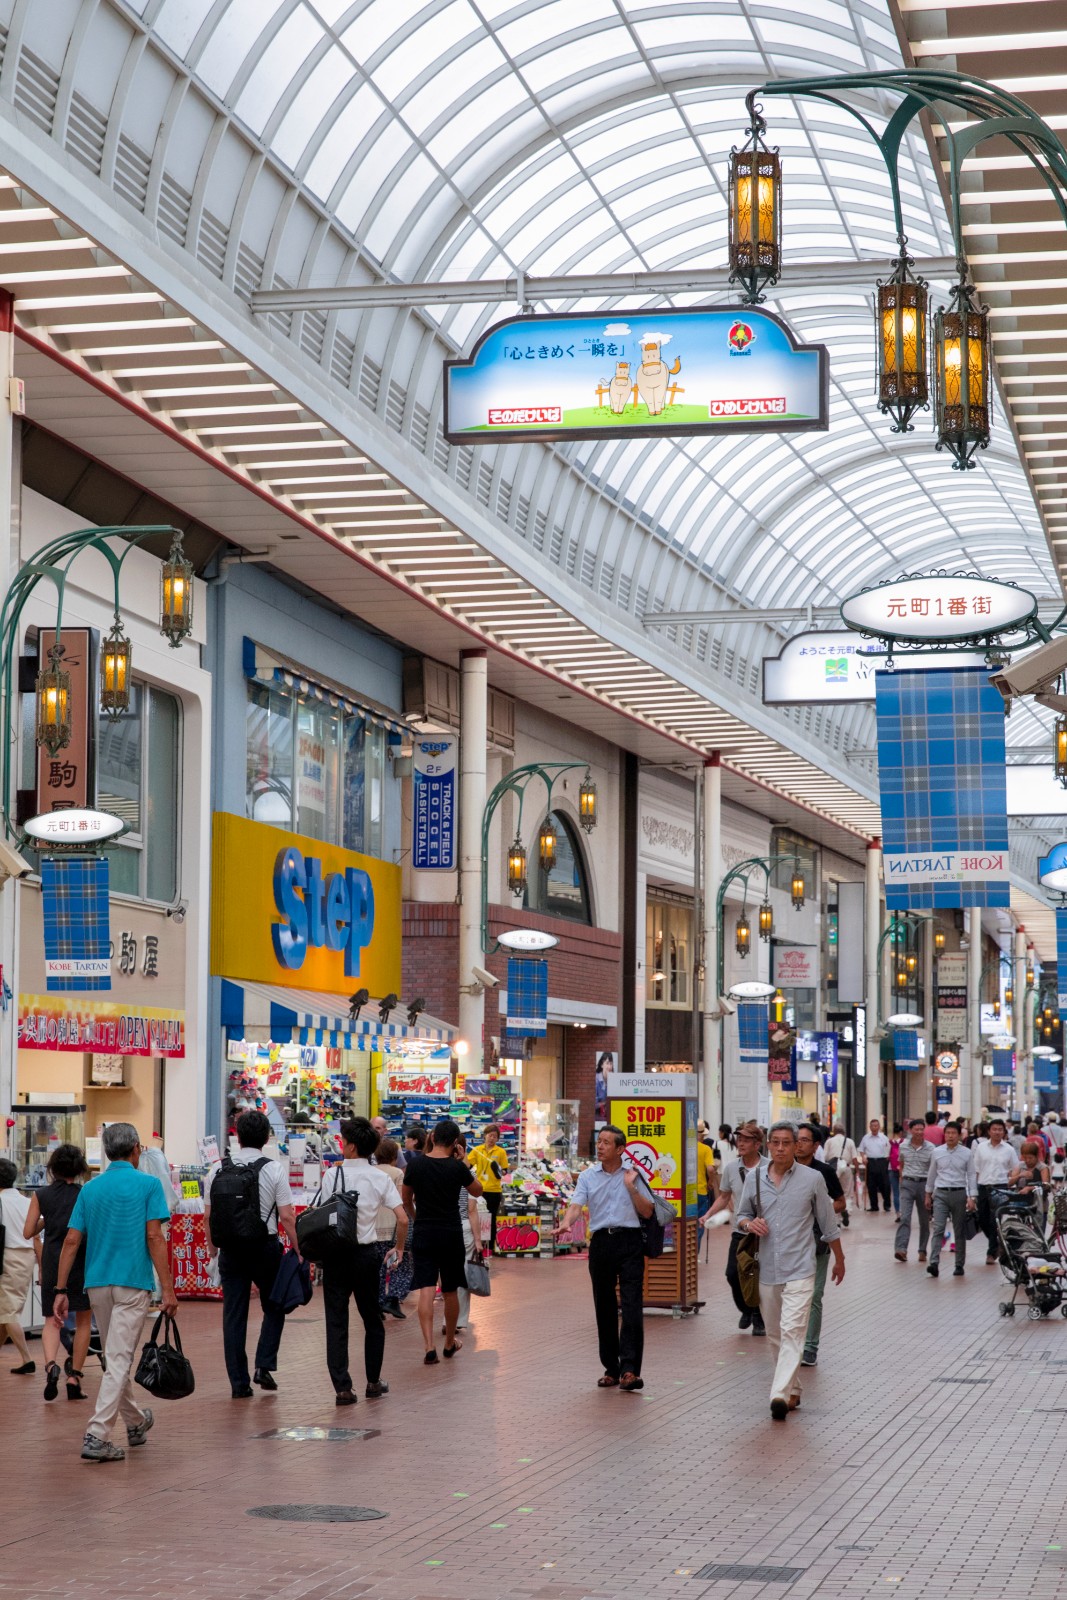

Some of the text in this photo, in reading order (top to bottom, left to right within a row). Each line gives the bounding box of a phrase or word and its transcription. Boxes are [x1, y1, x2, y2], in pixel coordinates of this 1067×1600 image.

[503, 342, 625, 360] 「心ときめく一瞬を」
[489, 408, 561, 424] そのだけいば
[710, 399, 785, 419] ひめじけいば
[887, 596, 992, 618] 元町1番街
[421, 742, 449, 753] Step
[442, 783, 452, 820] TRACK
[47, 820, 101, 832] 元町1番街
[418, 783, 428, 864] BASKETBALL
[430, 783, 440, 865] SOCCER
[441, 831, 451, 864] FIELD
[271, 847, 374, 977] Step
[49, 961, 109, 971] KOBE TARTAN
[118, 1015, 148, 1049] OPEN
[619, 1079, 673, 1087] INFORMATION
[627, 1106, 666, 1122] STOP
[627, 1124, 666, 1137] 自転車
[496, 1217, 517, 1228] SALE
